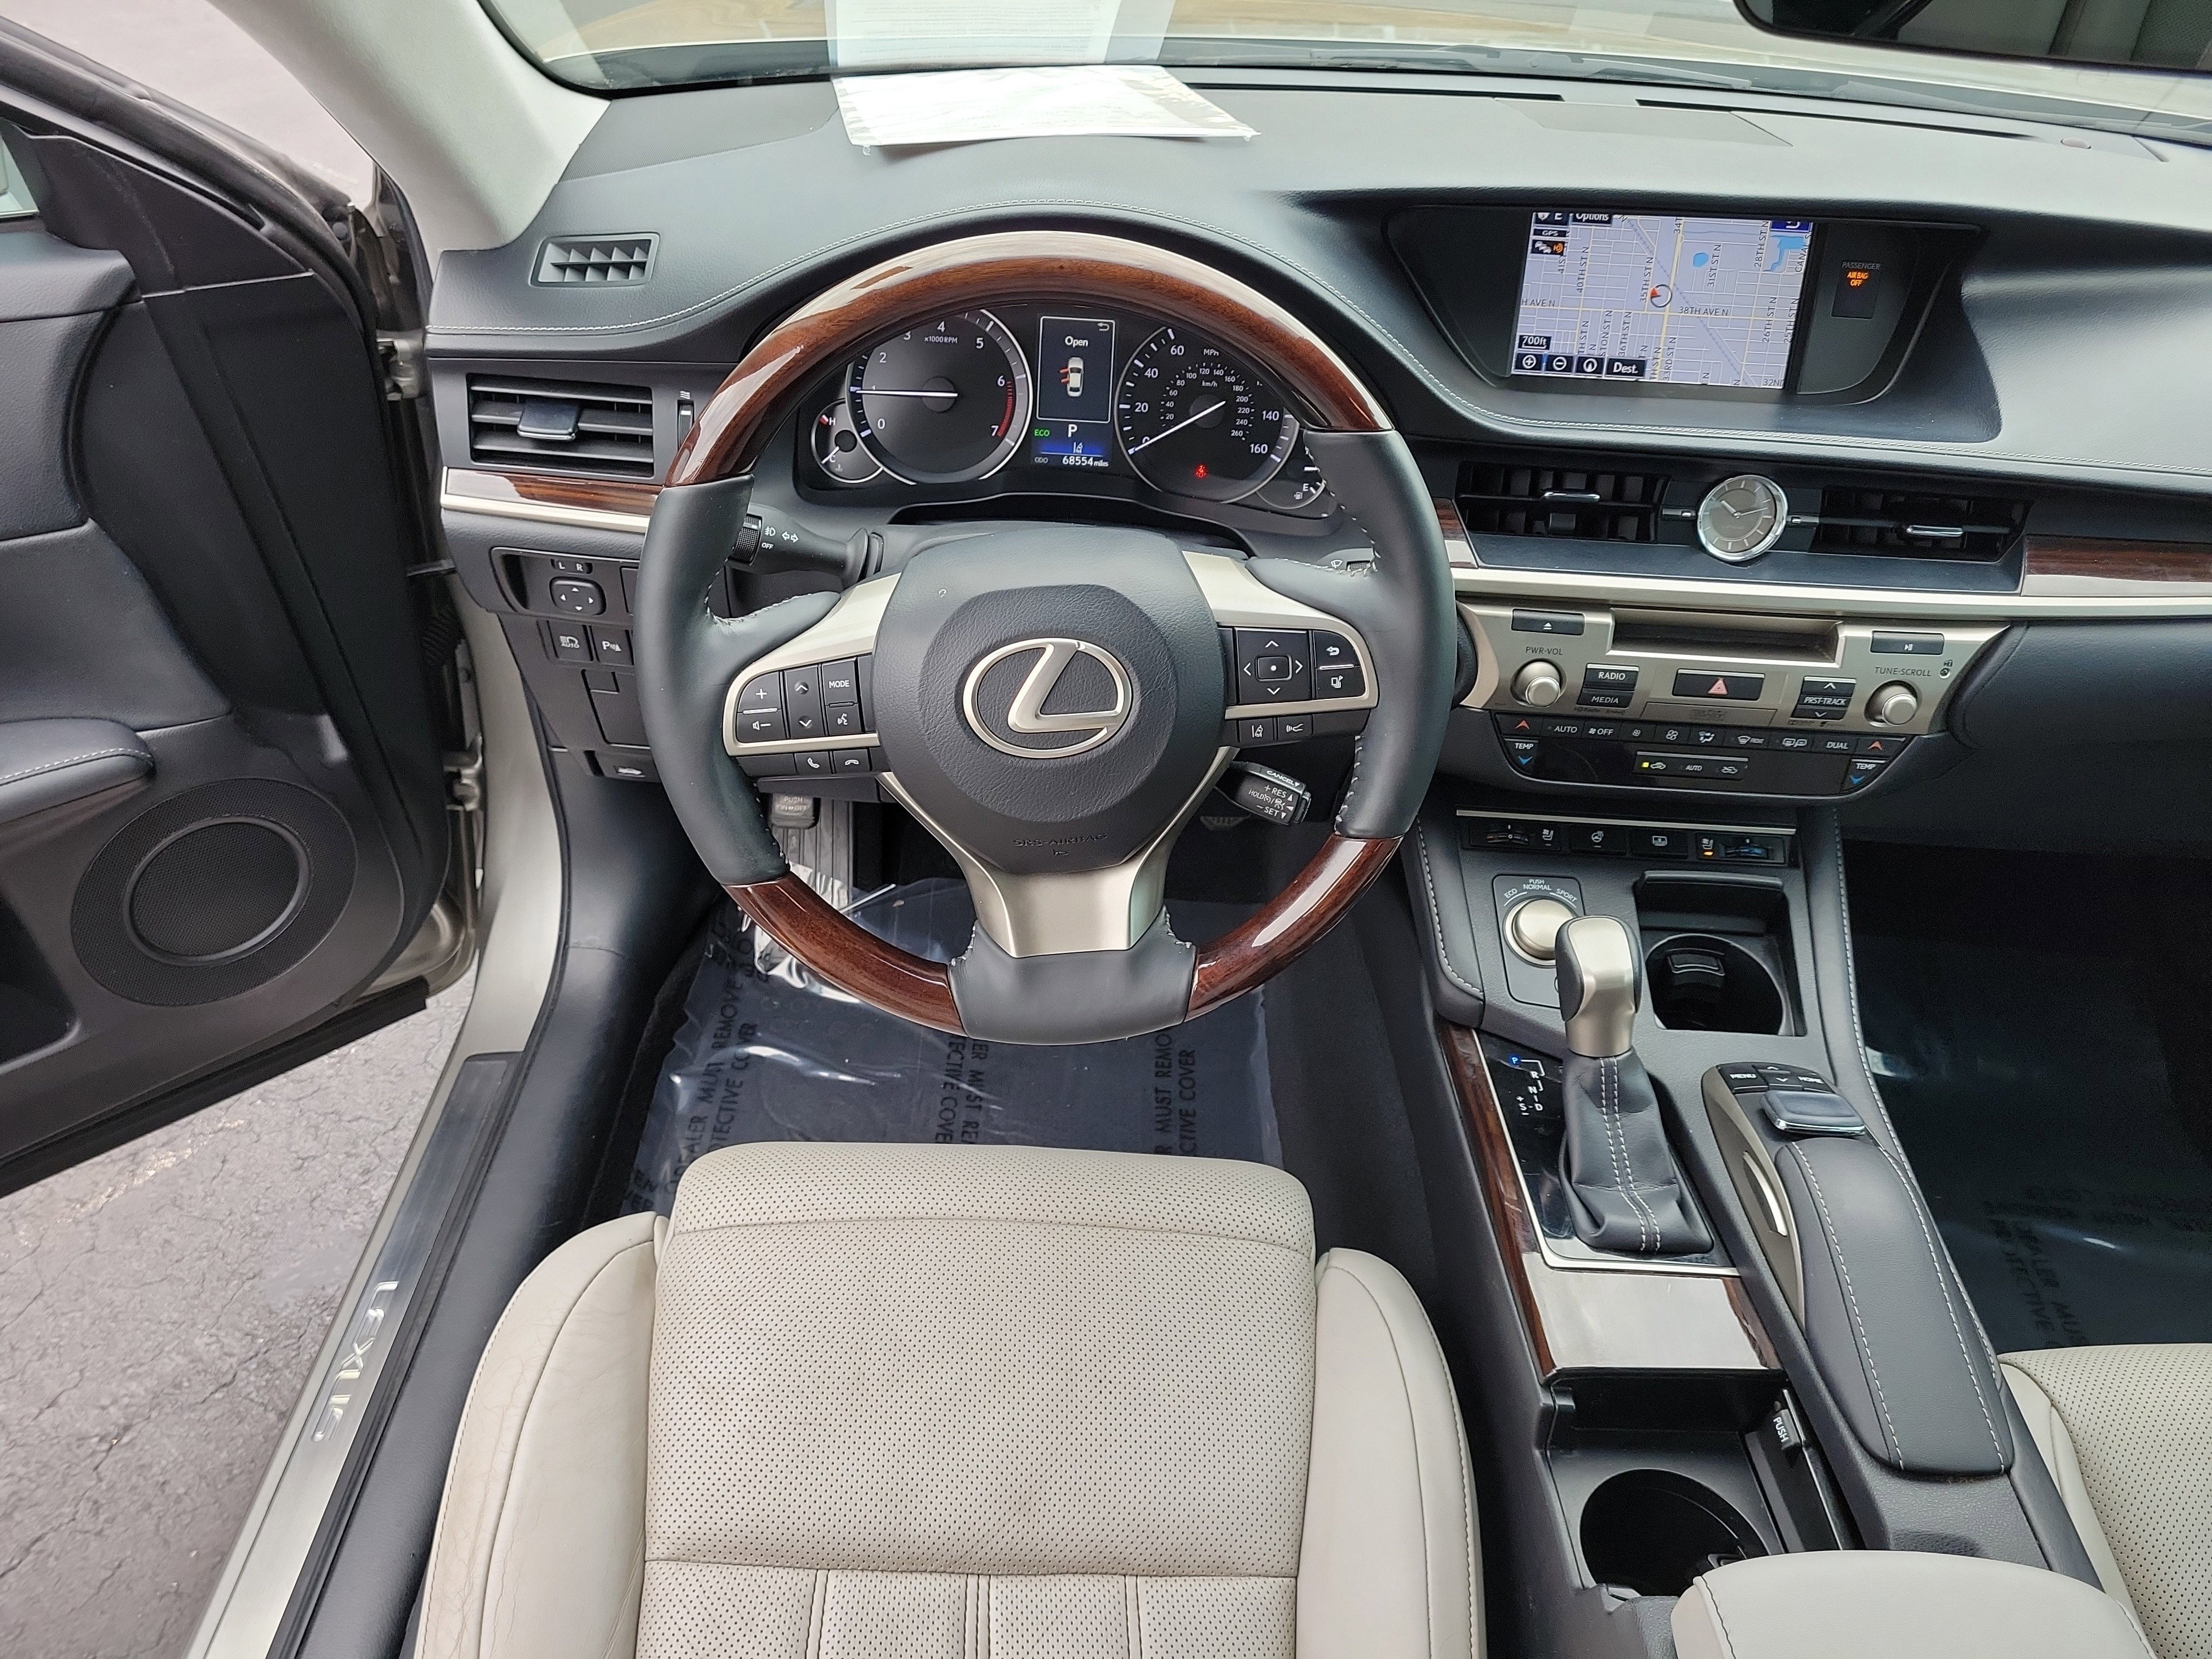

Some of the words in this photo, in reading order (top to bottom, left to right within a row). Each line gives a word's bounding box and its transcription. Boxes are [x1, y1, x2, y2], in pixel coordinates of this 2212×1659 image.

[1576, 213, 1610, 222] Options
[1759, 229, 1768, 241] ST
[1711, 253, 1719, 267] ST
[1754, 244, 1765, 268] 28TH
[1795, 242, 1809, 273] CANAL
[1580, 257, 1588, 267] ST
[1842, 262, 1881, 270] PASSENGER
[1644, 266, 1653, 277] ST
[1576, 270, 1585, 293] 40TH
[1707, 268, 1718, 287] 31ST
[1640, 280, 1651, 303] 35TH
[1679, 306, 1701, 315] 38TH
[1702, 308, 1721, 316] AVE
[1767, 305, 1775, 317] ST
[1788, 306, 1798, 318] ST
[936, 320, 946, 332] 4
[1604, 319, 1612, 331] ST
[1580, 331, 1588, 342] ST
[1762, 319, 1773, 343] 26TH
[1784, 320, 1796, 343] 25TH
[975, 337, 984, 349] 5
[1064, 336, 1089, 348] Open
[1522, 335, 1548, 346] 700ft
[1618, 334, 1628, 357] 36TH
[1623, 320, 1631, 331] ST
[1170, 345, 1184, 356] 60
[1667, 347, 1675, 358] ST
[879, 352, 887, 363] 2
[1652, 357, 1660, 368] ST
[1144, 368, 1159, 379] 40
[1612, 362, 1639, 374] Dest.
[1663, 360, 1673, 381] 33RD
[997, 375, 1006, 387] 6
[1135, 402, 1149, 413] 20
[1262, 410, 1279, 421] 140
[828, 417, 836, 426] H
[877, 418, 885, 430] 0
[991, 425, 1000, 437] 7
[1034, 428, 1050, 437] ECO
[1068, 424, 1078, 437] P
[1250, 443, 1268, 454] 160
[1062, 455, 1093, 466] 68554
[1303, 483, 1310, 492] E
[558, 561, 566, 569] L
[576, 563, 584, 572] R
[1598, 672, 1626, 680] RADIO
[828, 680, 850, 688] MODE
[1592, 696, 1619, 704] MEDIA
[1826, 741, 1849, 750] DUAL
[1266, 770, 1295, 786] CANCEL
[1248, 789, 1264, 799] HOLD
[1504, 888, 1518, 899] ECO
[1556, 888, 1578, 903] SPORT
[1178, 1049, 1197, 1102] COVER
[1527, 1086, 1538, 1094] N
[1154, 1086, 1172, 1133] MUST
[1519, 1103, 1527, 1111] S
[1773, 1417, 1790, 1443] PUSH
